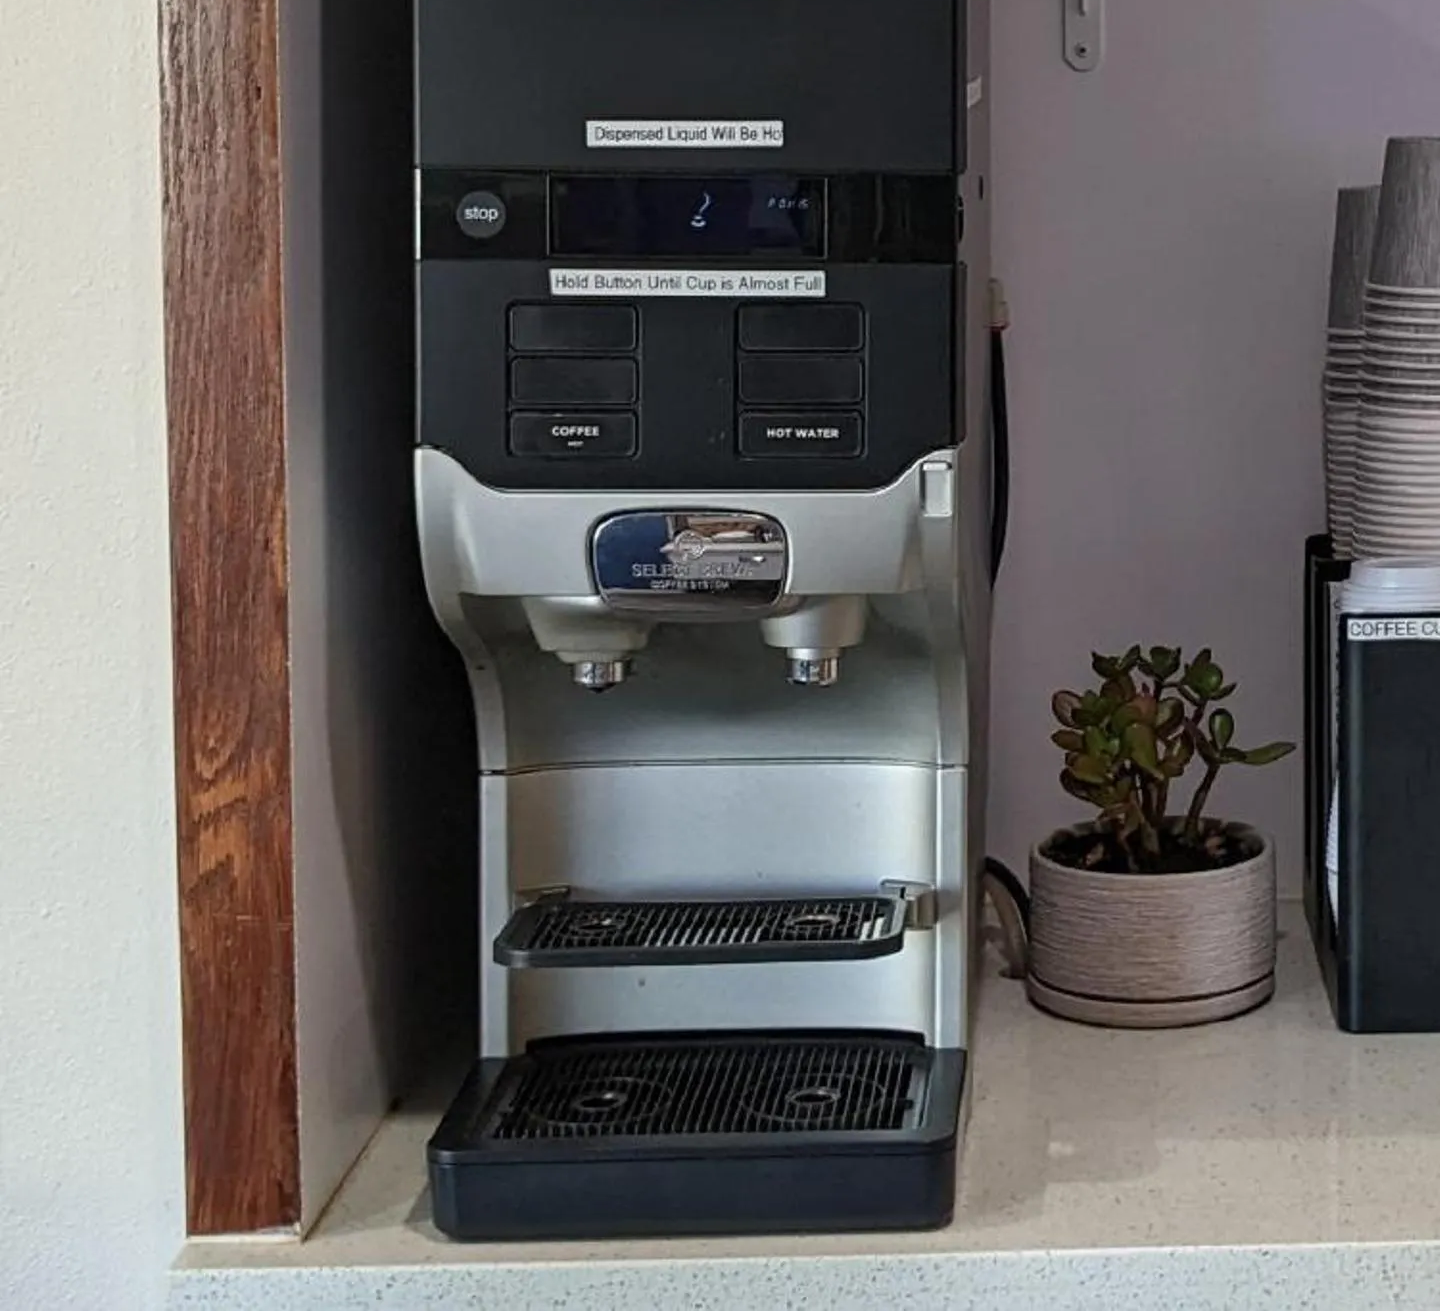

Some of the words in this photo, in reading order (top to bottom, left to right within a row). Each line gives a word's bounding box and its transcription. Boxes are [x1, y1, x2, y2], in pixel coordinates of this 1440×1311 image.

[594, 125, 664, 144] Dispensed
[667, 125, 707, 143] Liquid
[711, 125, 736, 140] Will
[739, 126, 758, 140] Be
[463, 204, 500, 224] stop
[554, 273, 589, 290] Hold
[593, 274, 643, 290] Button
[646, 274, 682, 291] Until
[686, 275, 718, 293] Cup
[720, 275, 734, 291] is
[738, 275, 790, 292] Almost
[793, 276, 823, 292] Full
[551, 425, 601, 437] COFFEE
[765, 427, 793, 439] HOT
[794, 427, 840, 439] WATER
[1349, 621, 1418, 638] COFFEE
